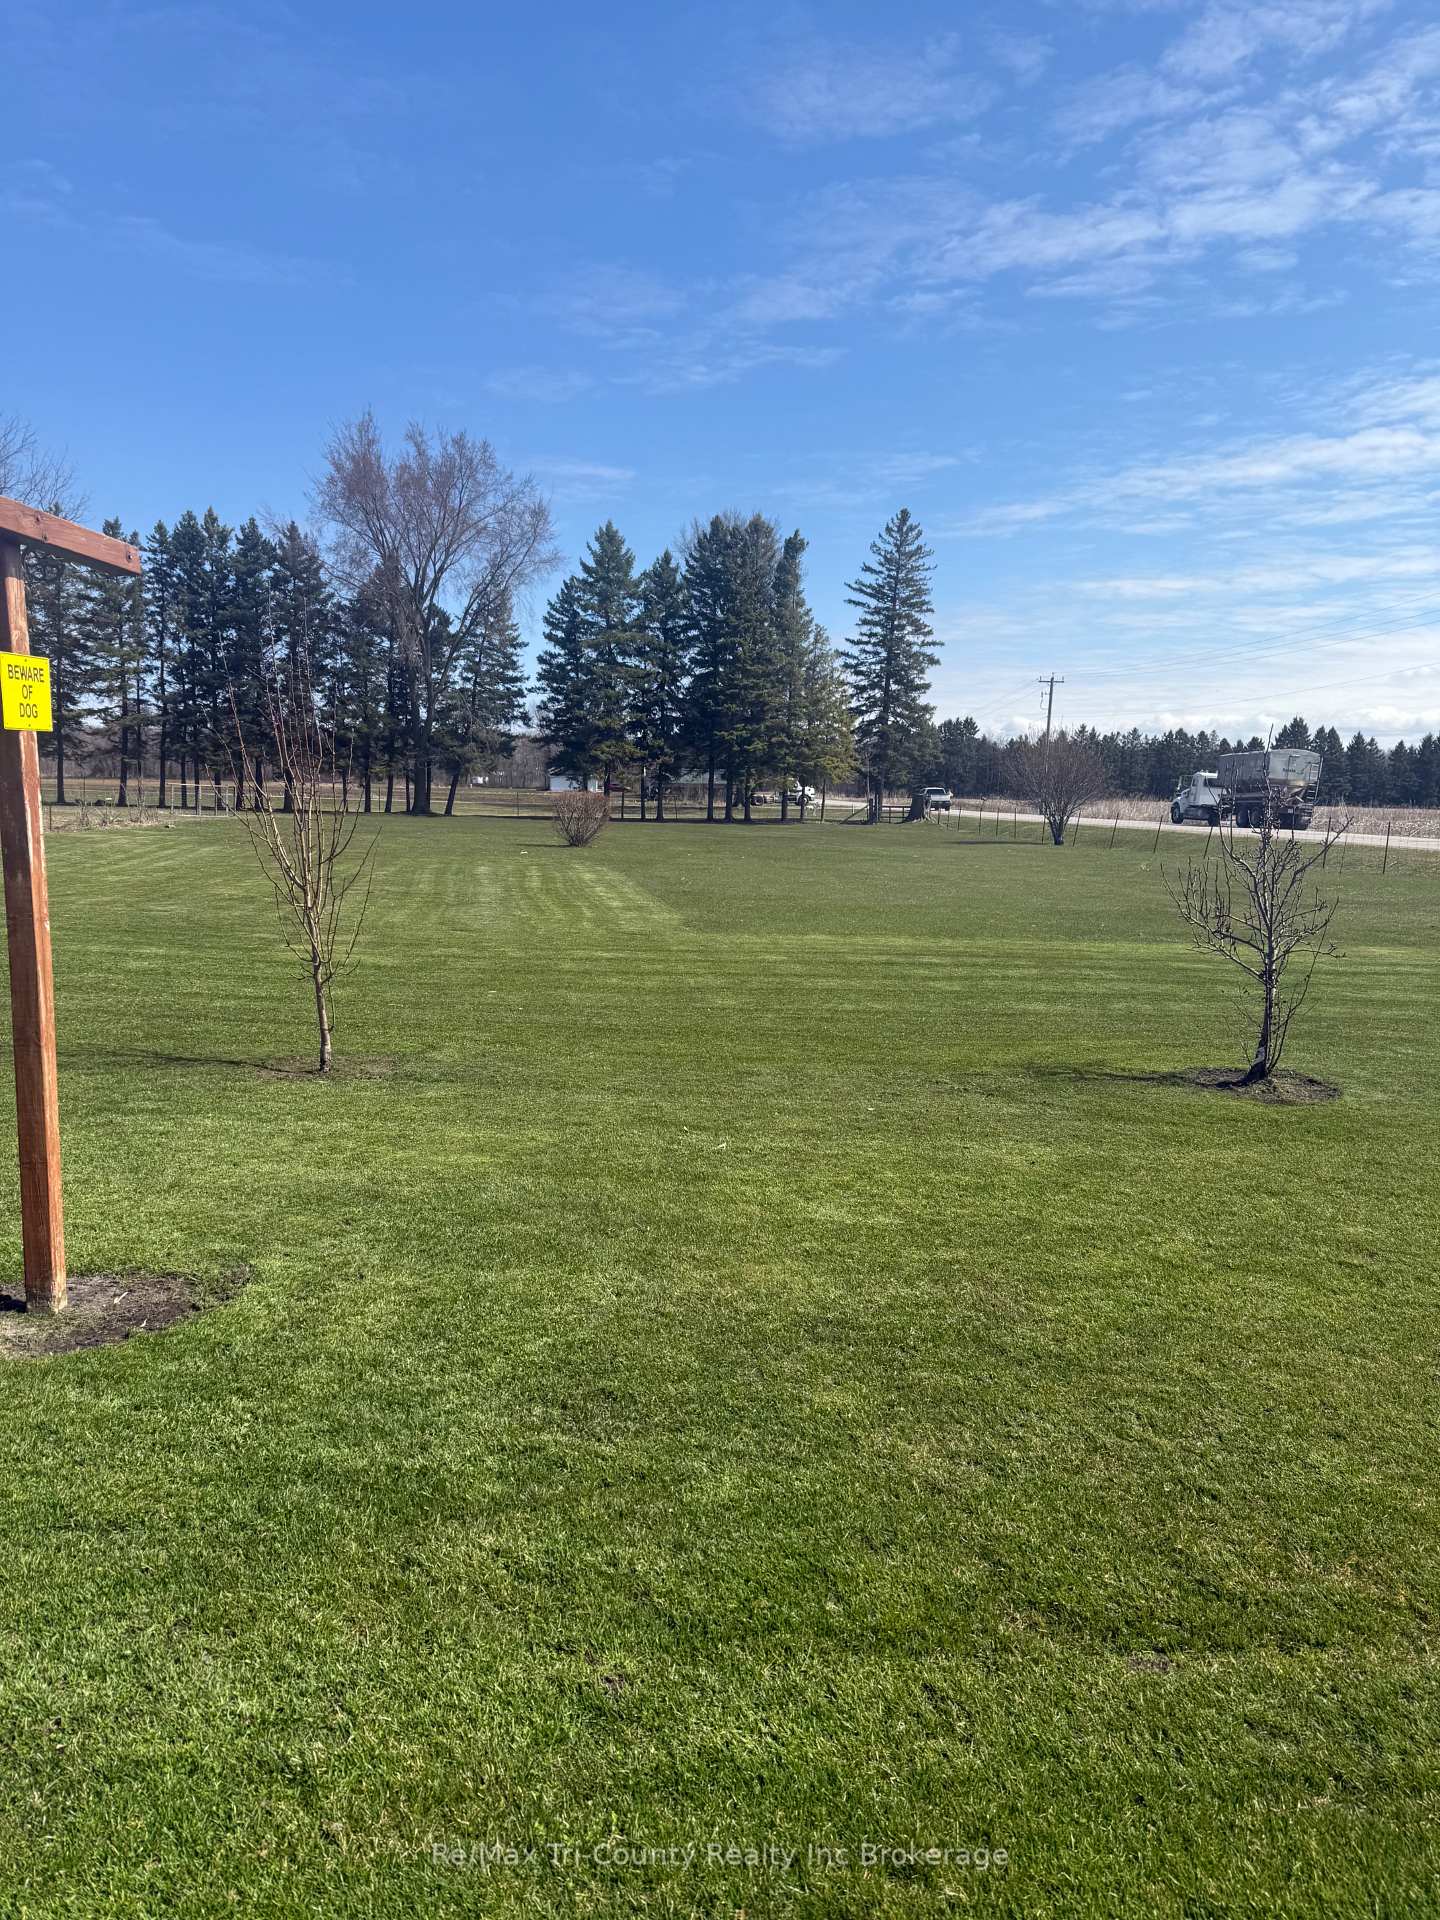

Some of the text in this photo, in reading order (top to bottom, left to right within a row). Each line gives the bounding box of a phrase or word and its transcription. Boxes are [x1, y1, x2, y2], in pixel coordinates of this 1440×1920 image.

[8, 664, 45, 683] BEWARE
[22, 684, 33, 700] OF
[19, 703, 38, 718] DOG
